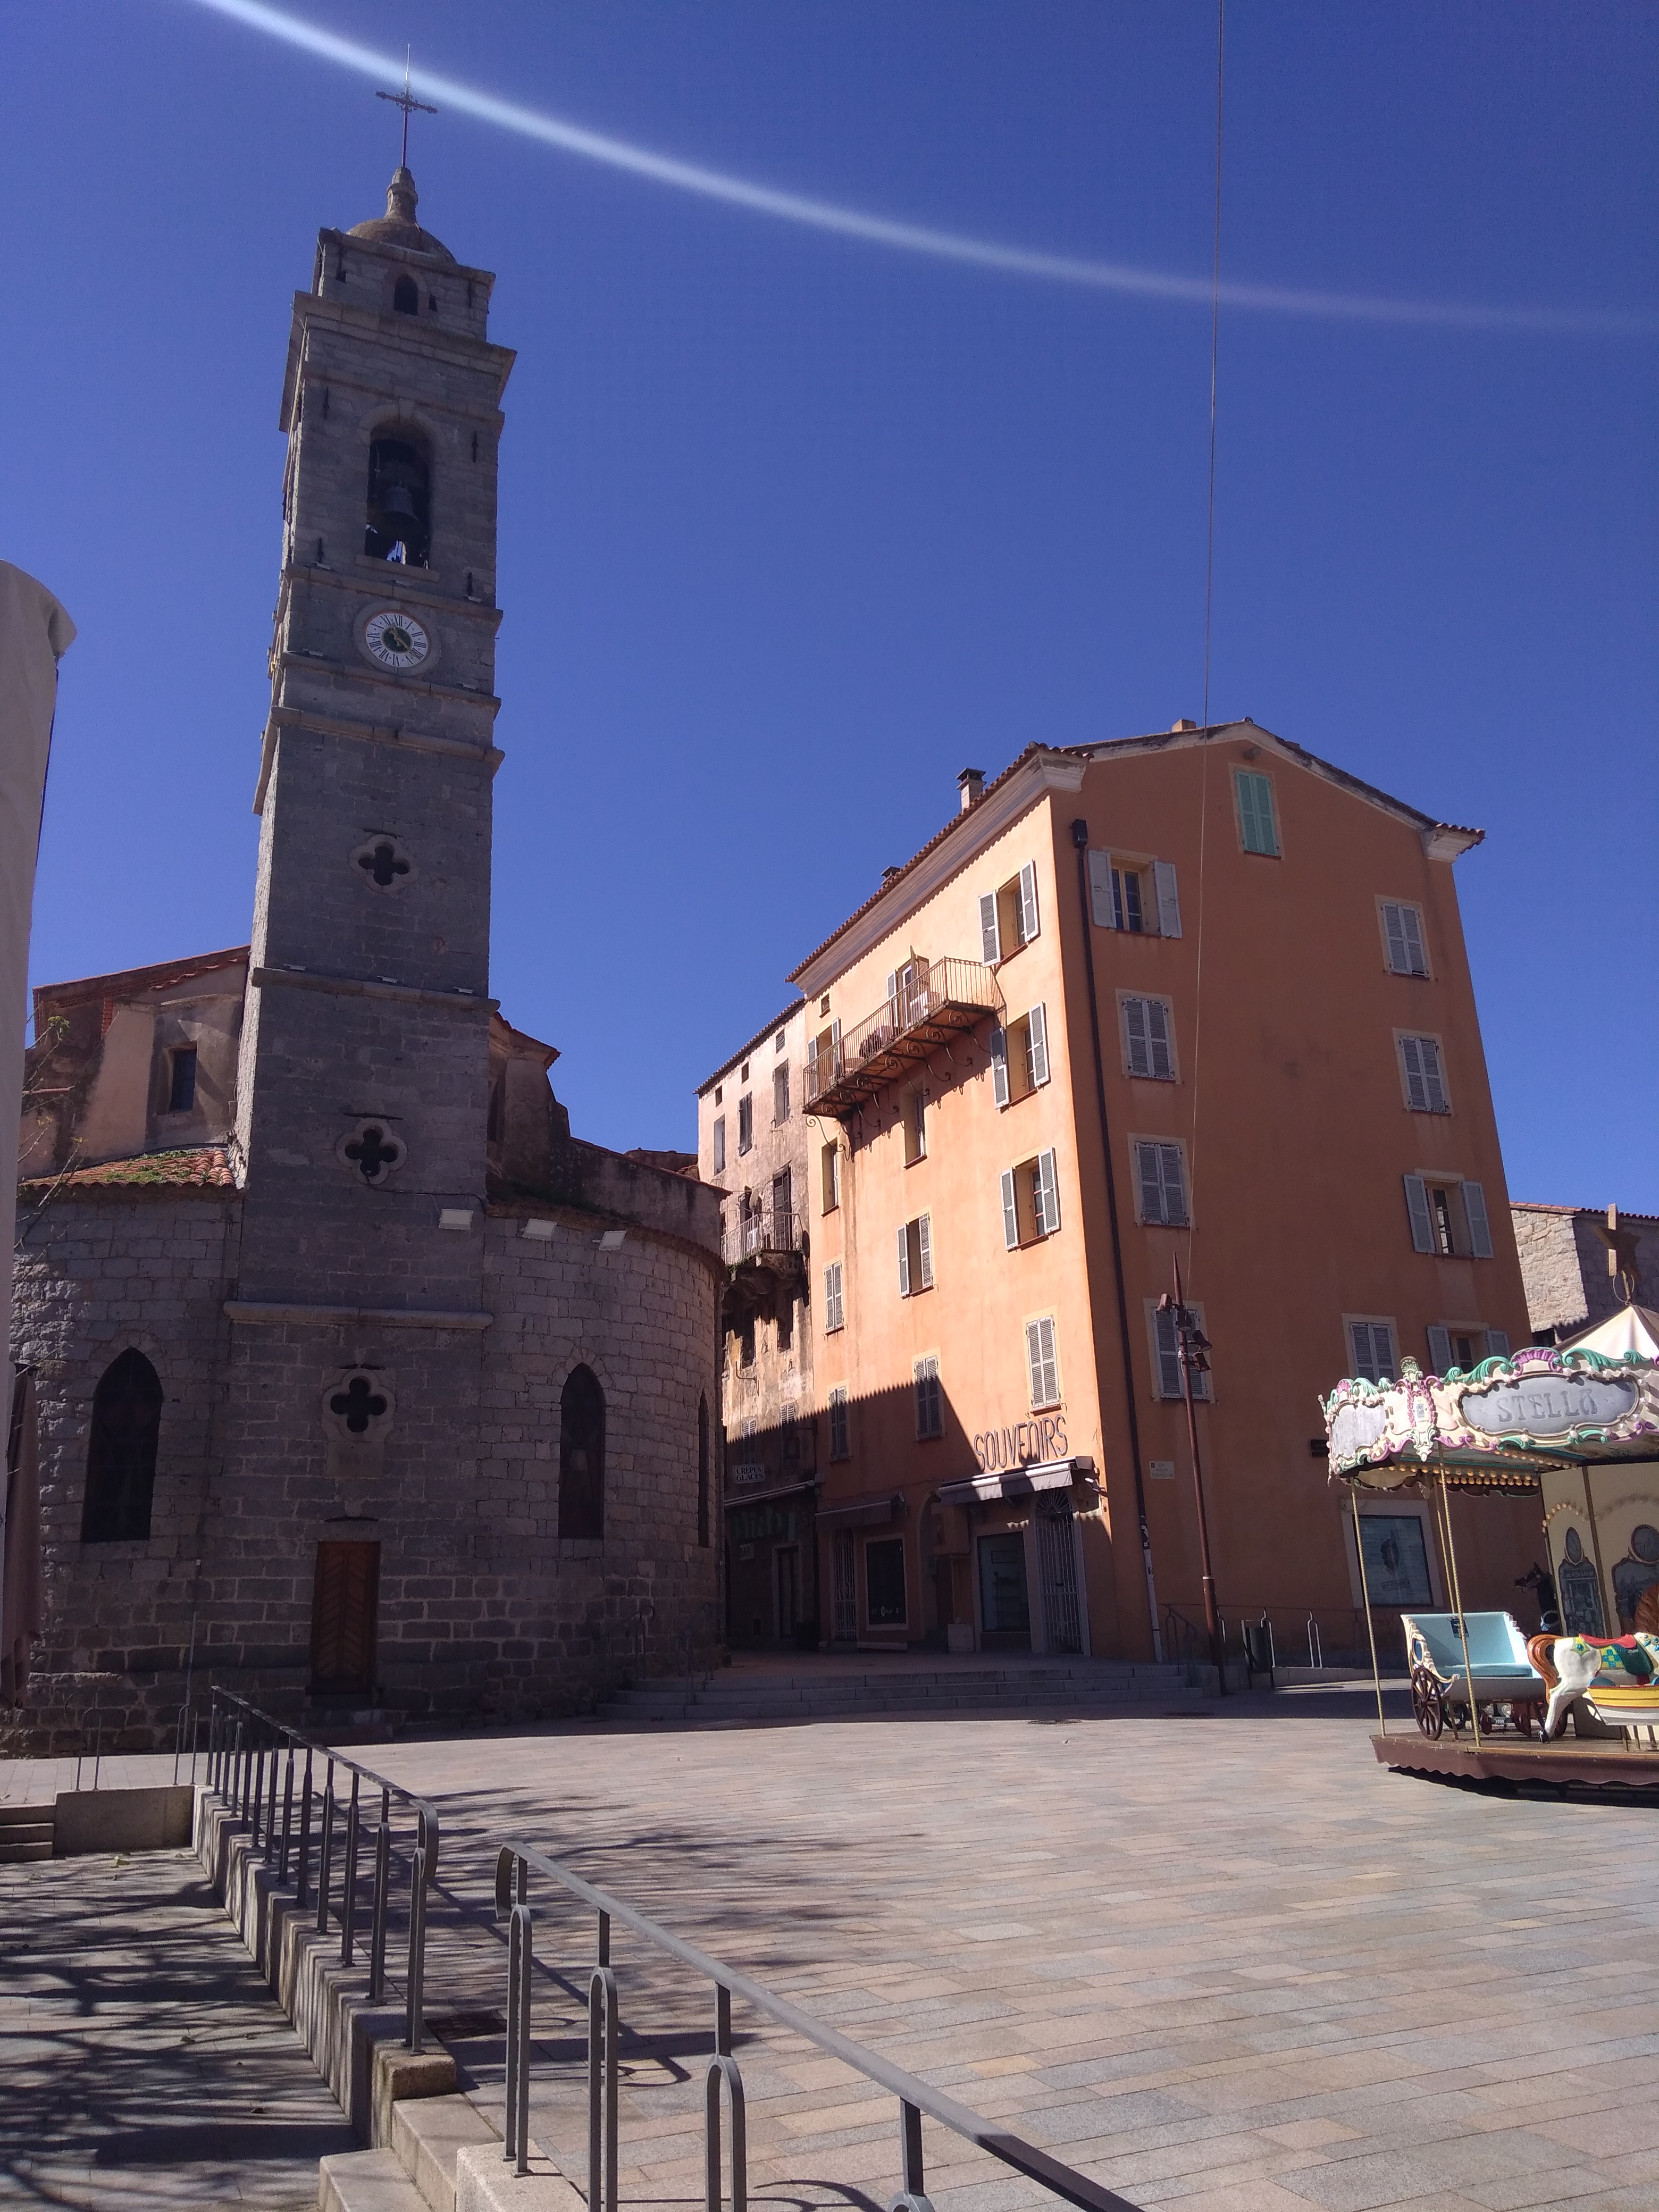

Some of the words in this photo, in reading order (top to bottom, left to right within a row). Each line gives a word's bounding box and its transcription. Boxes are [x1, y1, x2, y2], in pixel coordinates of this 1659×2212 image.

[406, 621, 413, 630] I
[1497, 1389, 1598, 1422] STELLA
[974, 1414, 1068, 1471] SOUVENIRS
